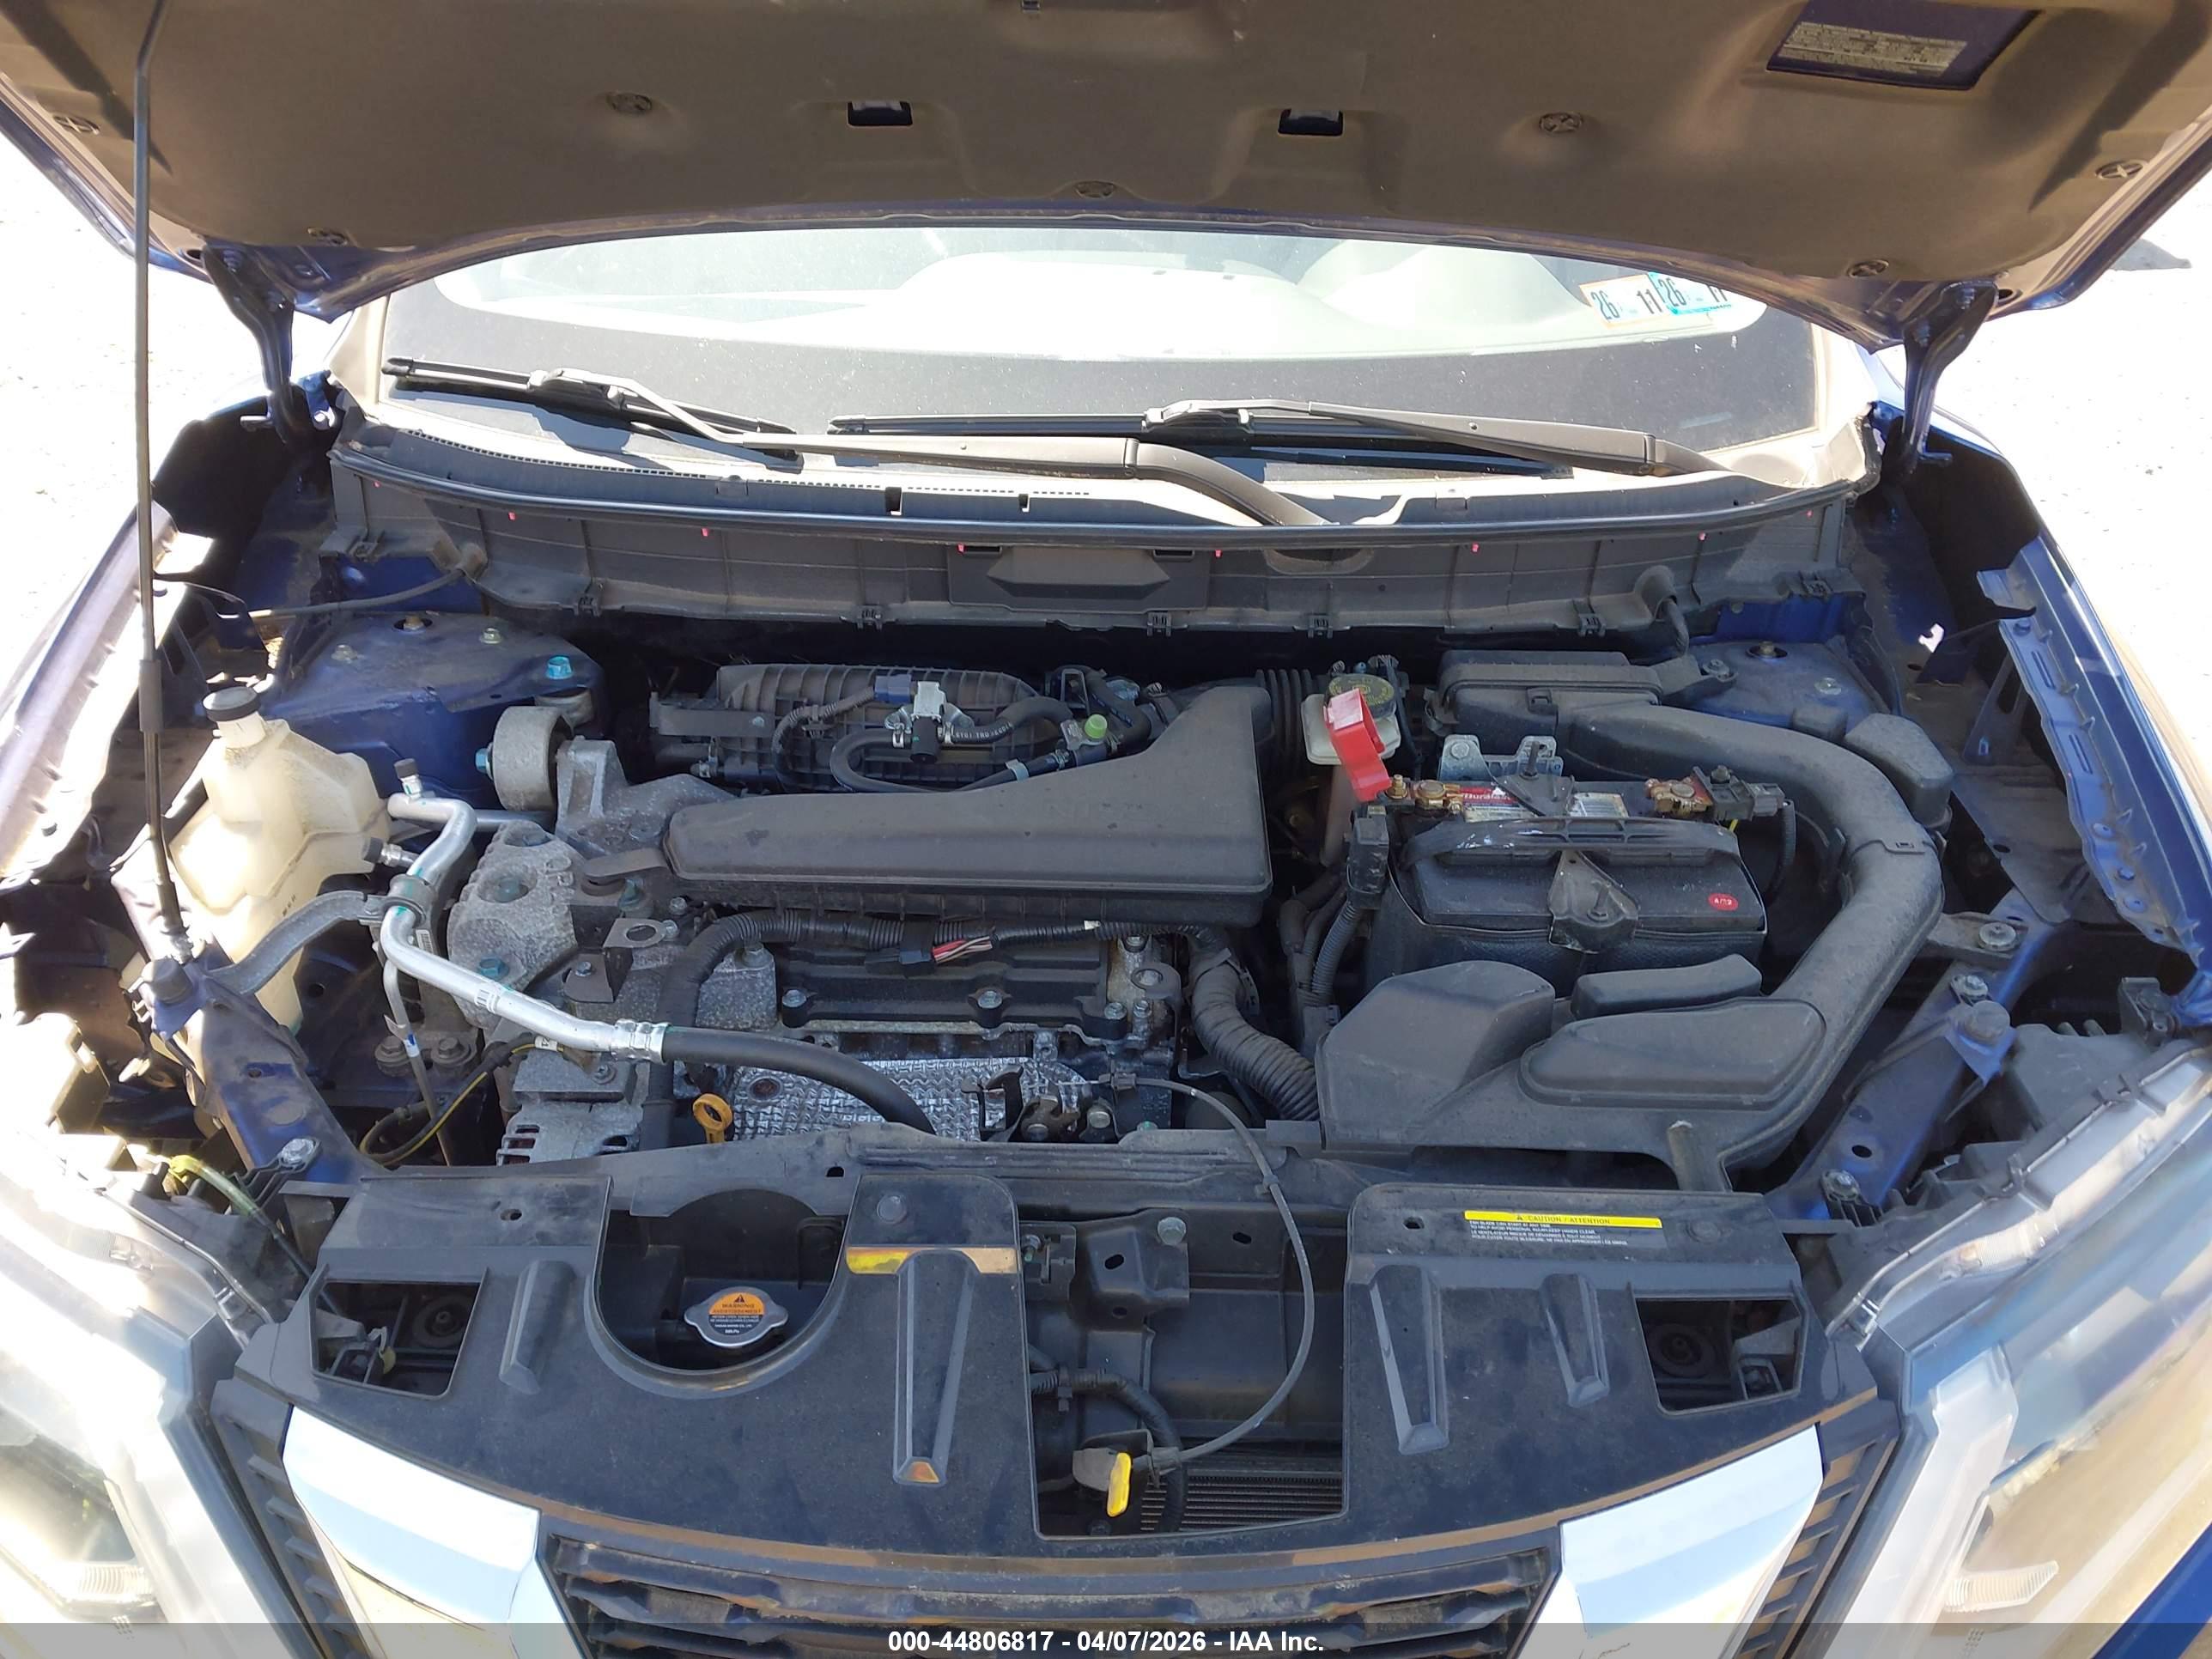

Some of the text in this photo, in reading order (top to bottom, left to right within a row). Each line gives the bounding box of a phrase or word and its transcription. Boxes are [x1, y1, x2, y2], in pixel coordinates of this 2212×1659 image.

[1591, 289, 1662, 320] 26 11
[1660, 277, 1687, 307] 26
